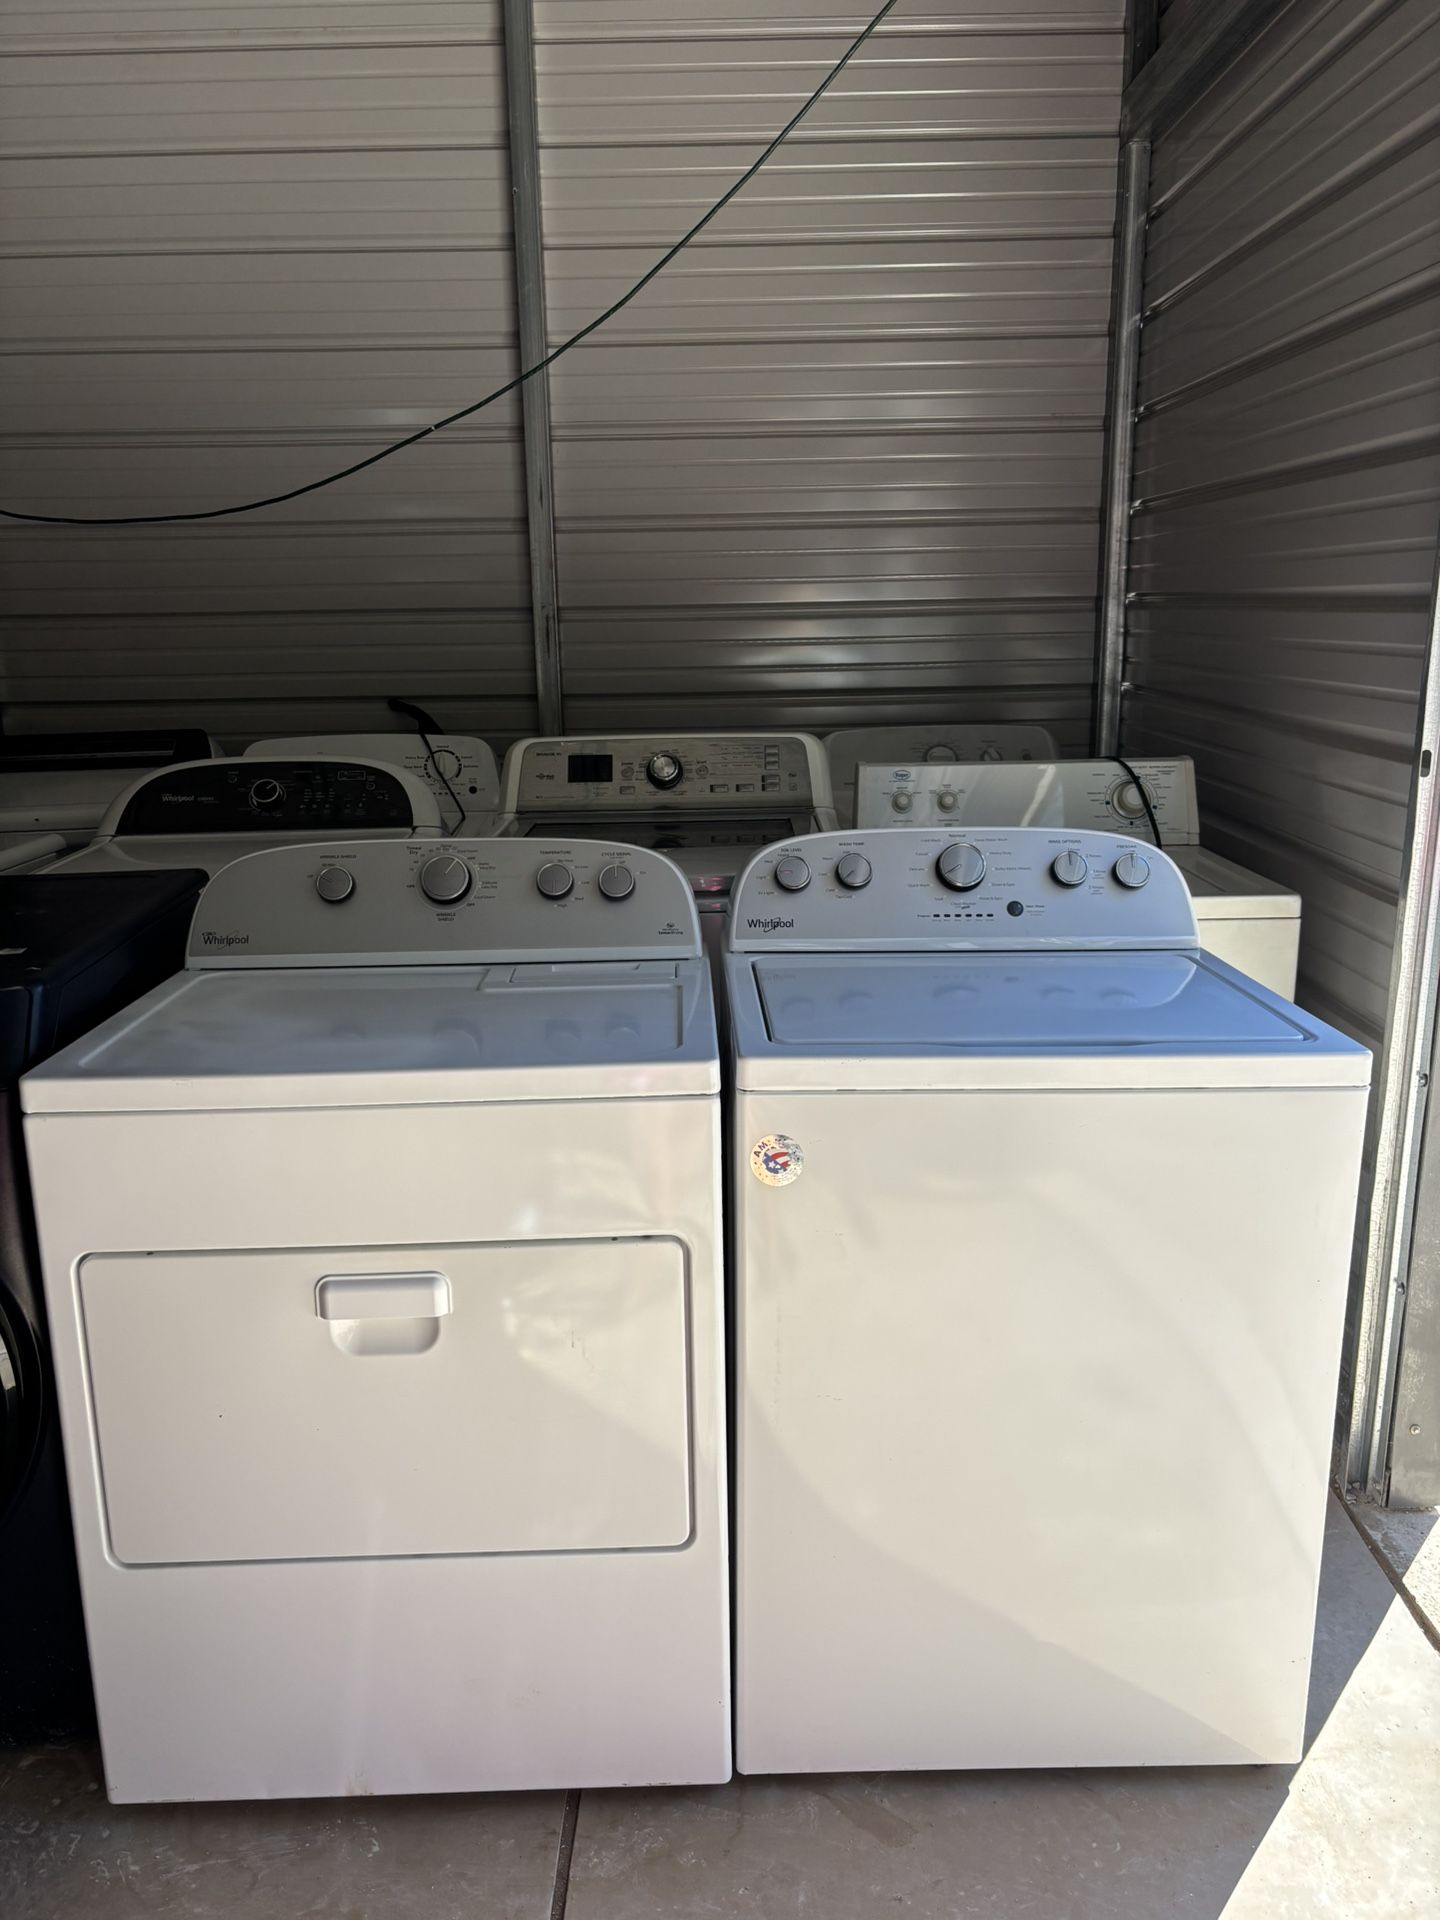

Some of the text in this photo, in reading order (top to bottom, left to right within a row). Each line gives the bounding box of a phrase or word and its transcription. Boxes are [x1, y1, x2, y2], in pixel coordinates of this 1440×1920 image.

[162, 795, 194, 803] Whirlpool
[747, 918, 794, 931] Whirlpool
[203, 935, 249, 947] Whirlpool
